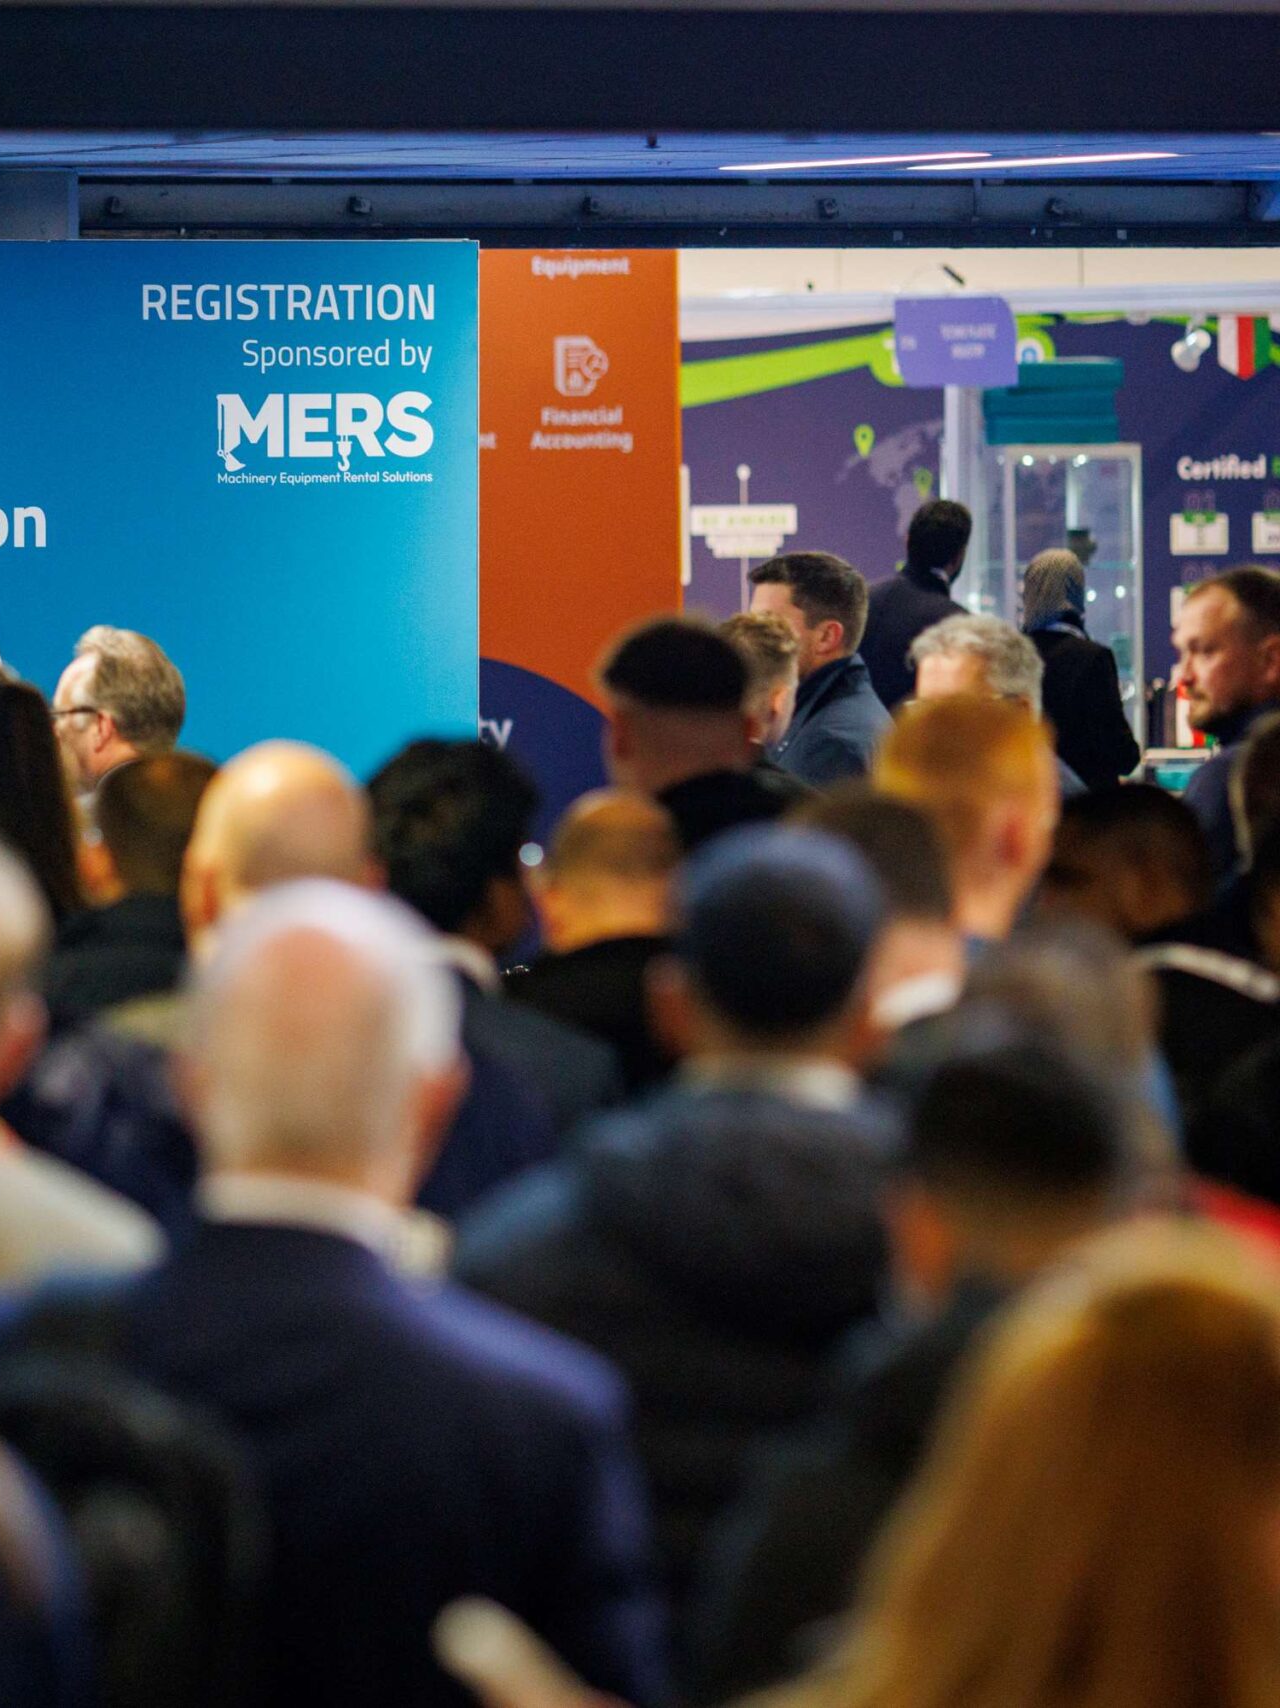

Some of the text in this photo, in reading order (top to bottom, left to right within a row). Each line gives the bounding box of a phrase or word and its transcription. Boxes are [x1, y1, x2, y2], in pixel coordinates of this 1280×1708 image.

[531, 256, 630, 279] Equipment
[142, 284, 435, 321] REGISTRATION
[242, 338, 432, 374] Sponsored by
[216, 390, 435, 462] MERS
[541, 406, 624, 425] Financial
[531, 431, 634, 453] Accounting
[217, 471, 433, 486] Machinery Equipment Rental Solutions
[1177, 454, 1267, 481] Certified
